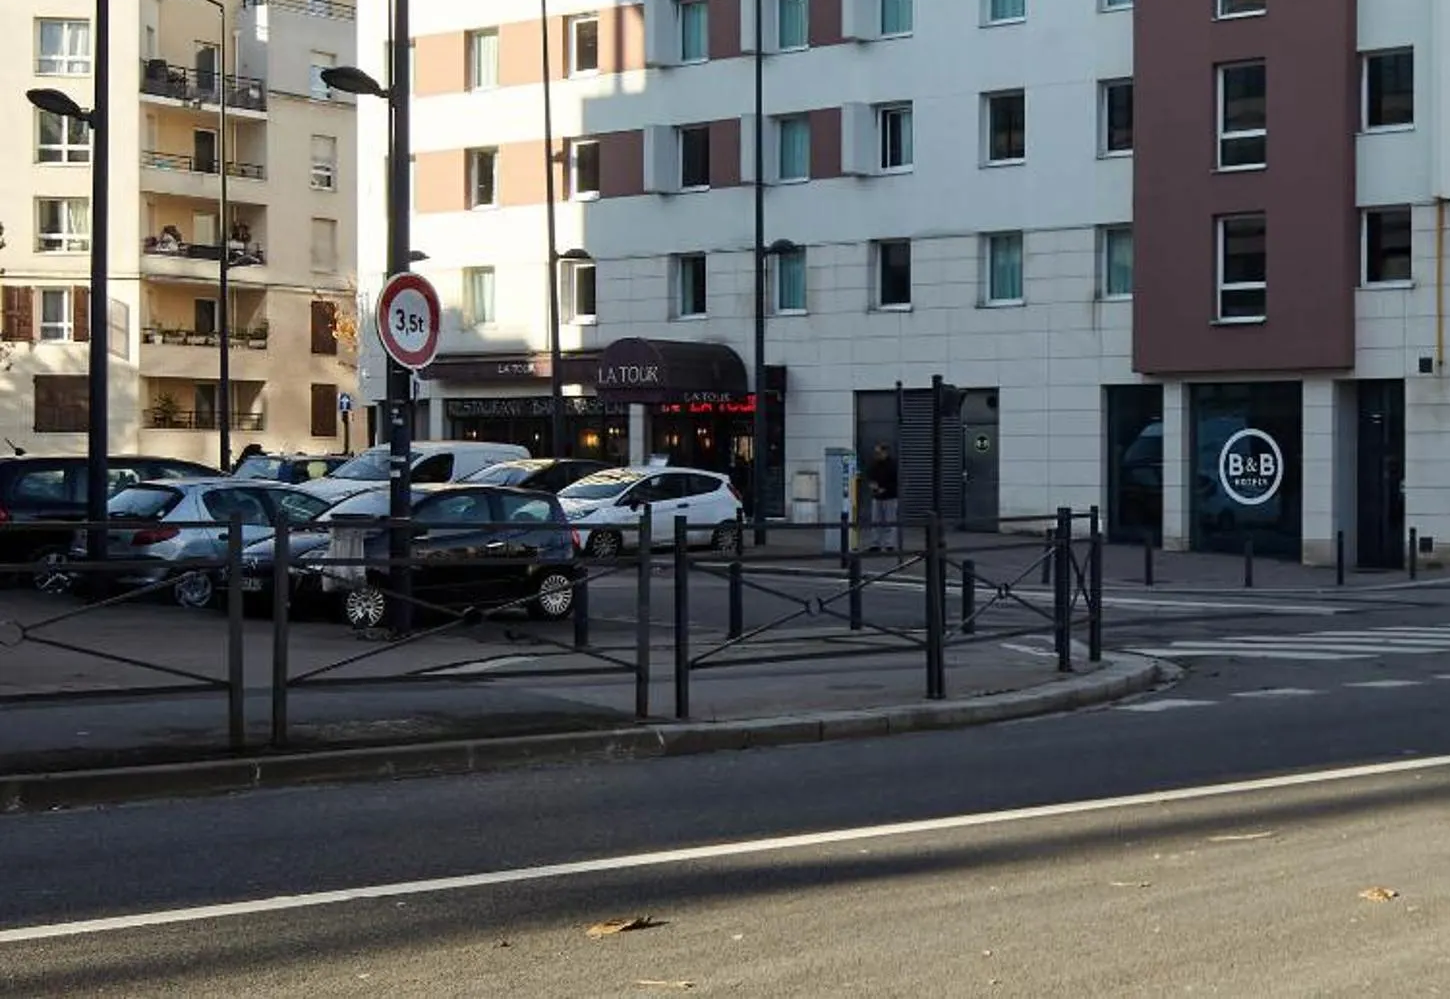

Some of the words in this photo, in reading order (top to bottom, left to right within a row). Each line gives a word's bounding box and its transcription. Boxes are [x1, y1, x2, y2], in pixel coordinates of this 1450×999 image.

[396, 309, 425, 336] 3,5t
[598, 367, 618, 384] LA
[1229, 453, 1275, 476] B&B
